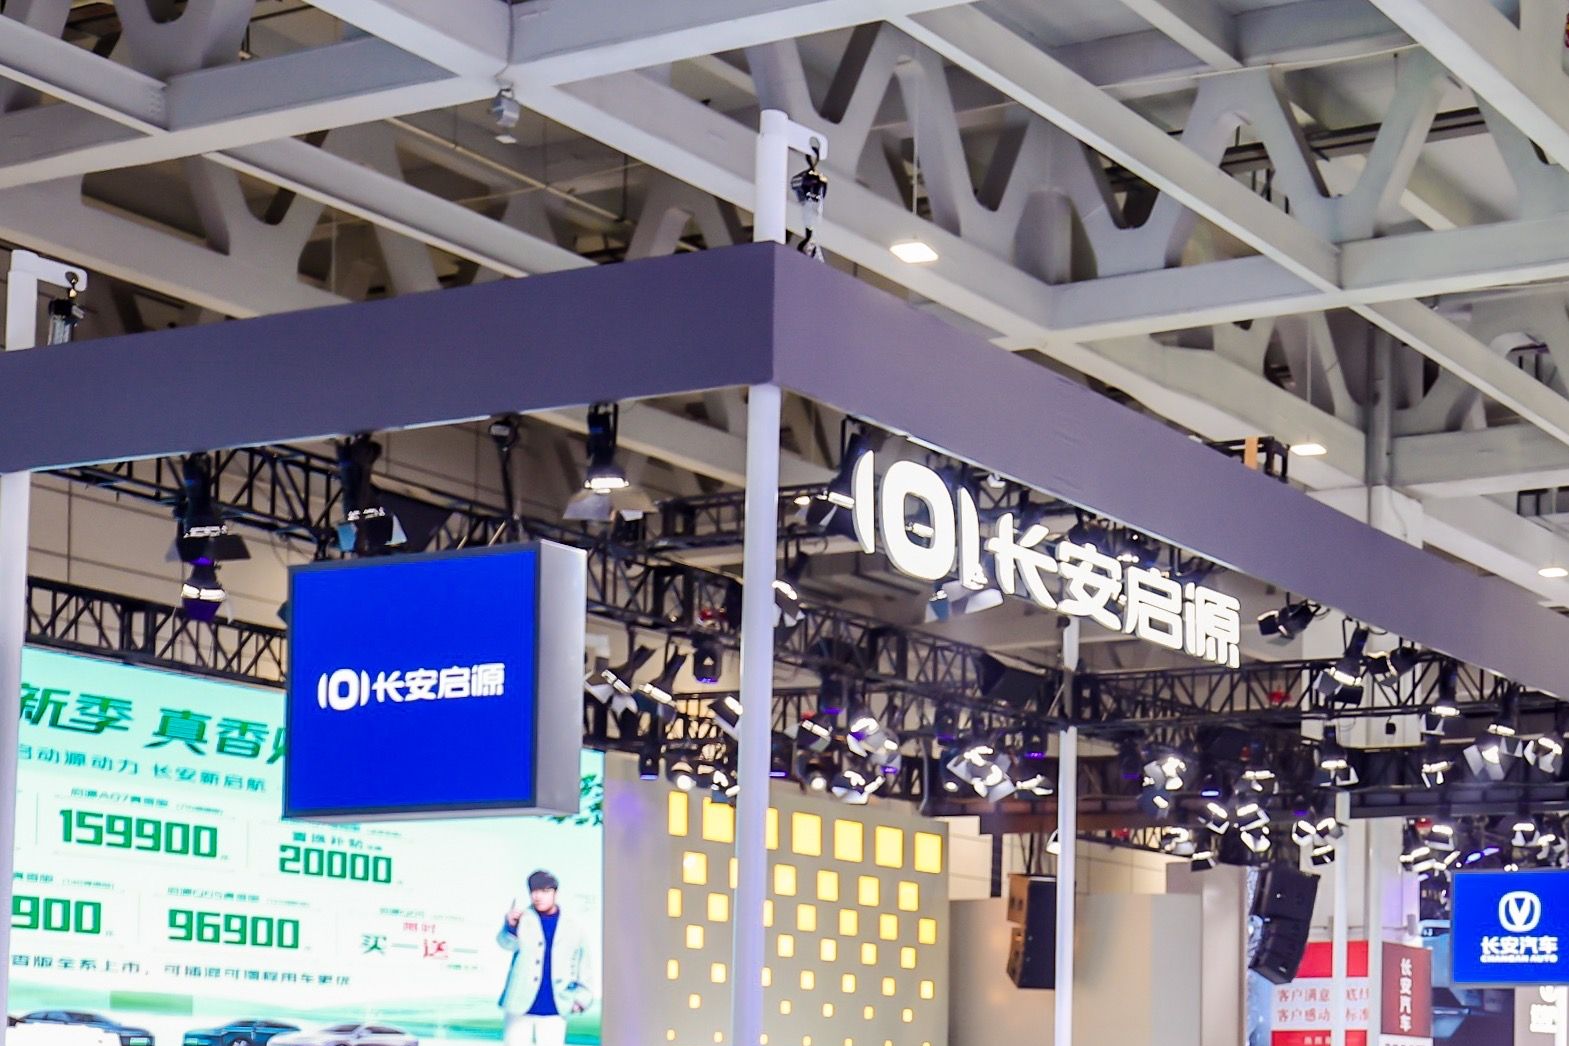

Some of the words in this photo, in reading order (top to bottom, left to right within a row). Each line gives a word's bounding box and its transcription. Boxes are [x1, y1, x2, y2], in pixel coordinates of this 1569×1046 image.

[984, 512, 1242, 669] 长安启源
[371, 663, 506, 703] 长安启源
[59, 808, 218, 858] 159900
[279, 844, 393, 884] 20000
[168, 908, 300, 950] 96900
[1480, 935, 1559, 955] 长安汽车
[1399, 958, 1413, 1032] 长安汽车
